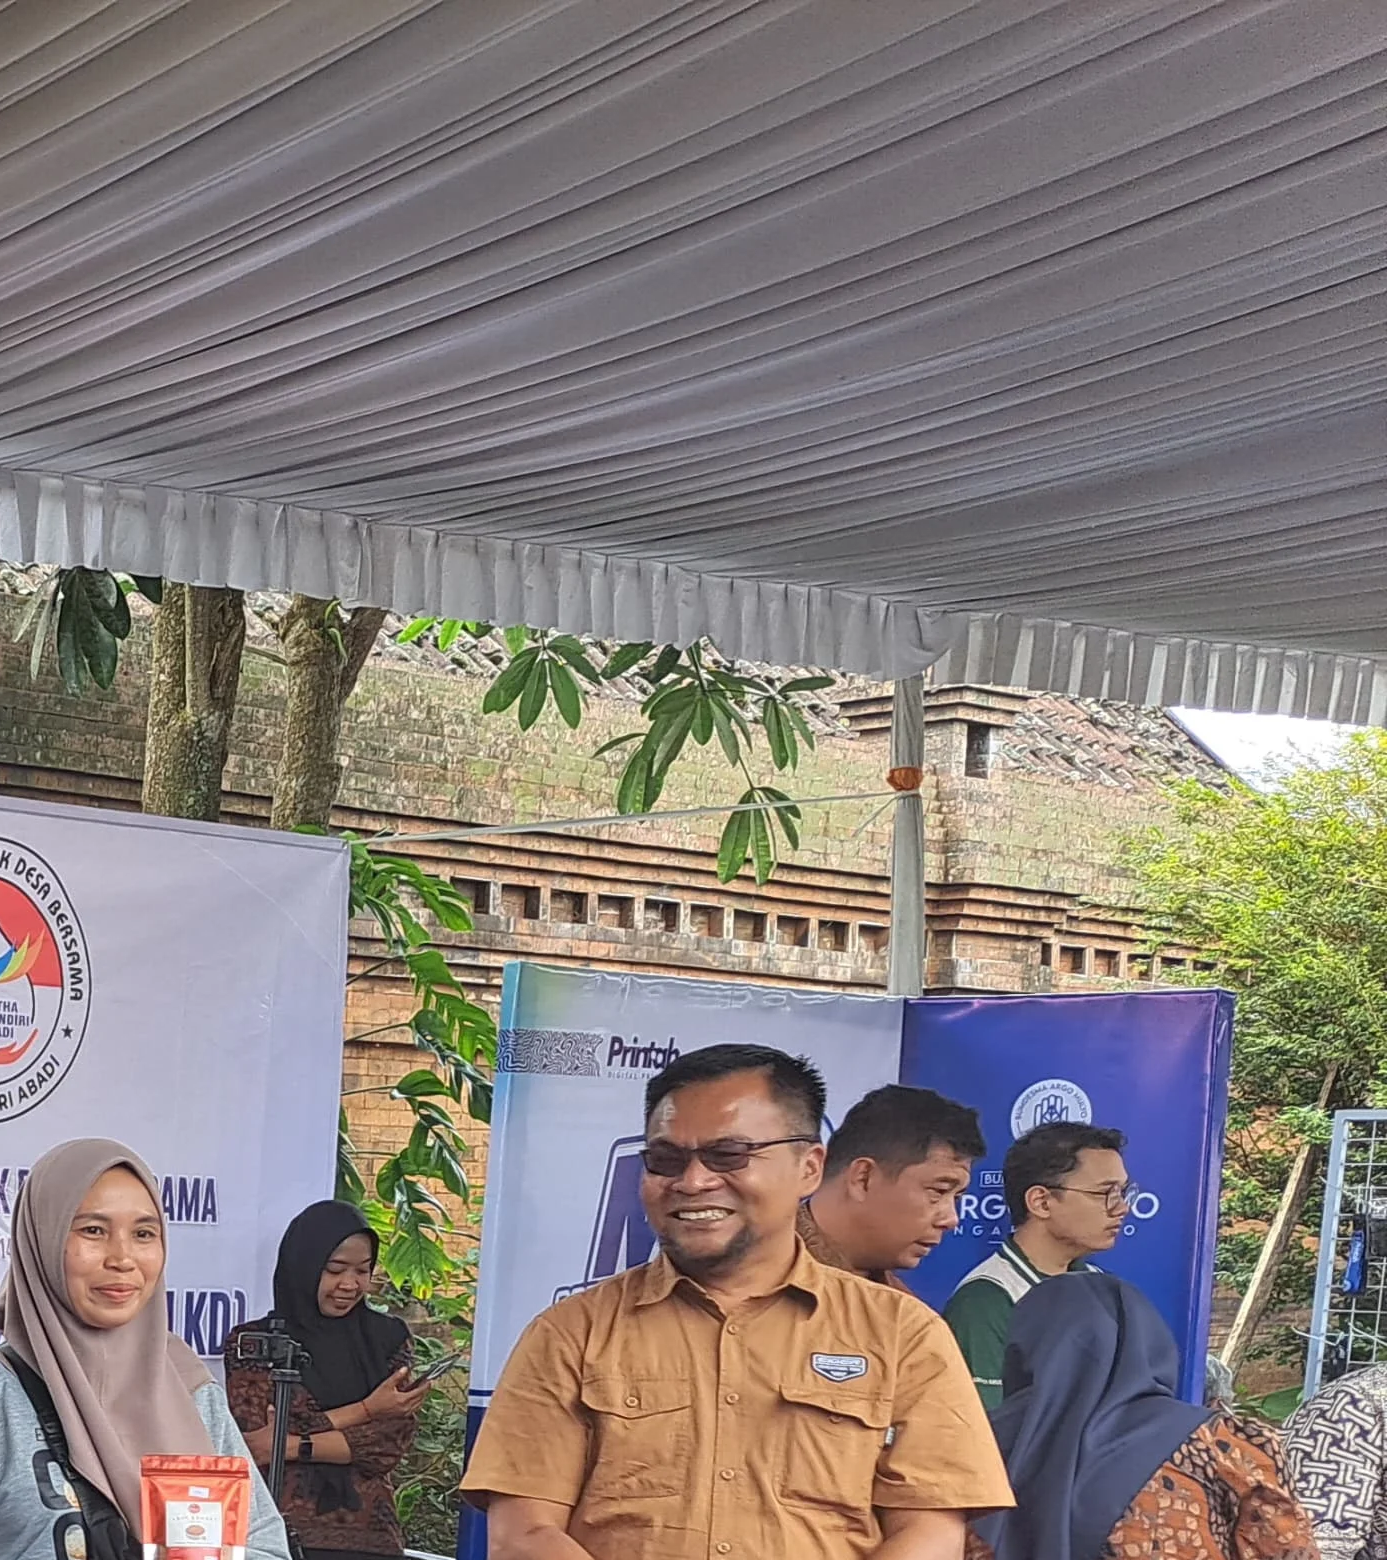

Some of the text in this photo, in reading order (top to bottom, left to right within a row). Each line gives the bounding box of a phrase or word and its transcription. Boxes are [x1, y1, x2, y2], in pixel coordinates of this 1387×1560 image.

[13, 858, 52, 901] DESA
[47, 900, 83, 1001] BERSAMA
[18, 1053, 60, 1101] ABADI
[1050, 1082, 1074, 1095] ARGO
[158, 1175, 218, 1224] AMA
